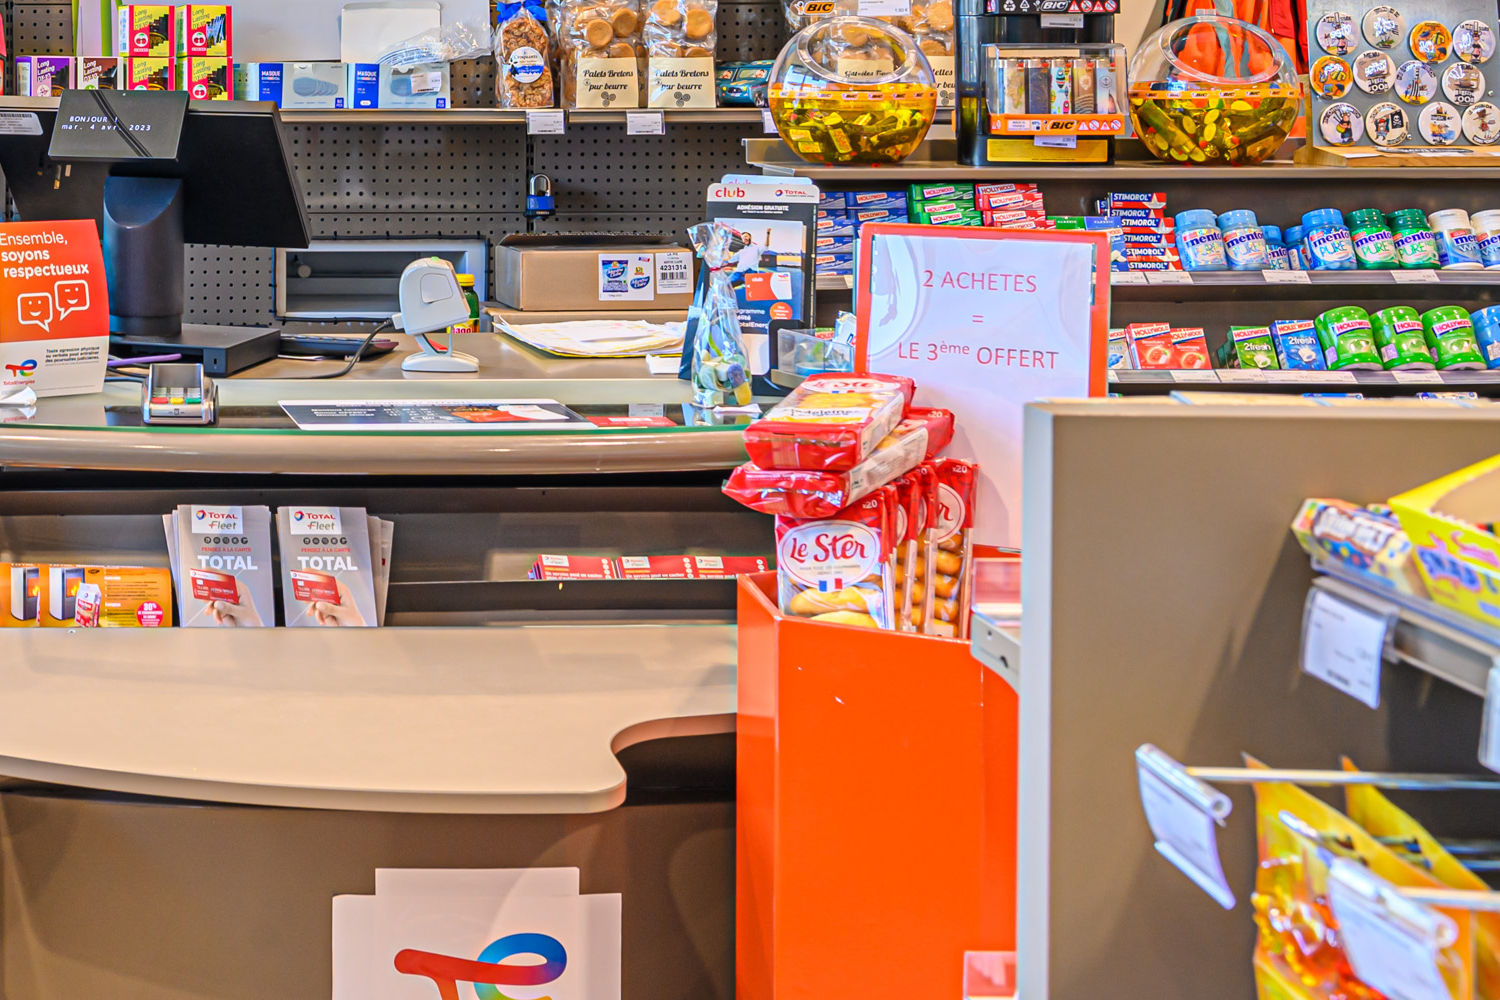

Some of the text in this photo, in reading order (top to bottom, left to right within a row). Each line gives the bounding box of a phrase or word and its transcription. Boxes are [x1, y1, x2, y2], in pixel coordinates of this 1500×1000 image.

[589, 84, 601, 92] pur
[715, 187, 745, 198] club
[1113, 194, 1148, 202] STIMOROL
[1, 248, 50, 262] soyons
[3, 262, 89, 280] respectueux
[923, 270, 1037, 293] 2 ACHETES
[1288, 337, 1315, 346] 2fresh
[899, 342, 919, 360] LE
[976, 348, 1059, 369] OFFERT
[862, 500, 877, 509] x20
[789, 534, 869, 562] Le Ster
[198, 556, 258, 570] TOTAL
[297, 556, 358, 570] TOTAL
